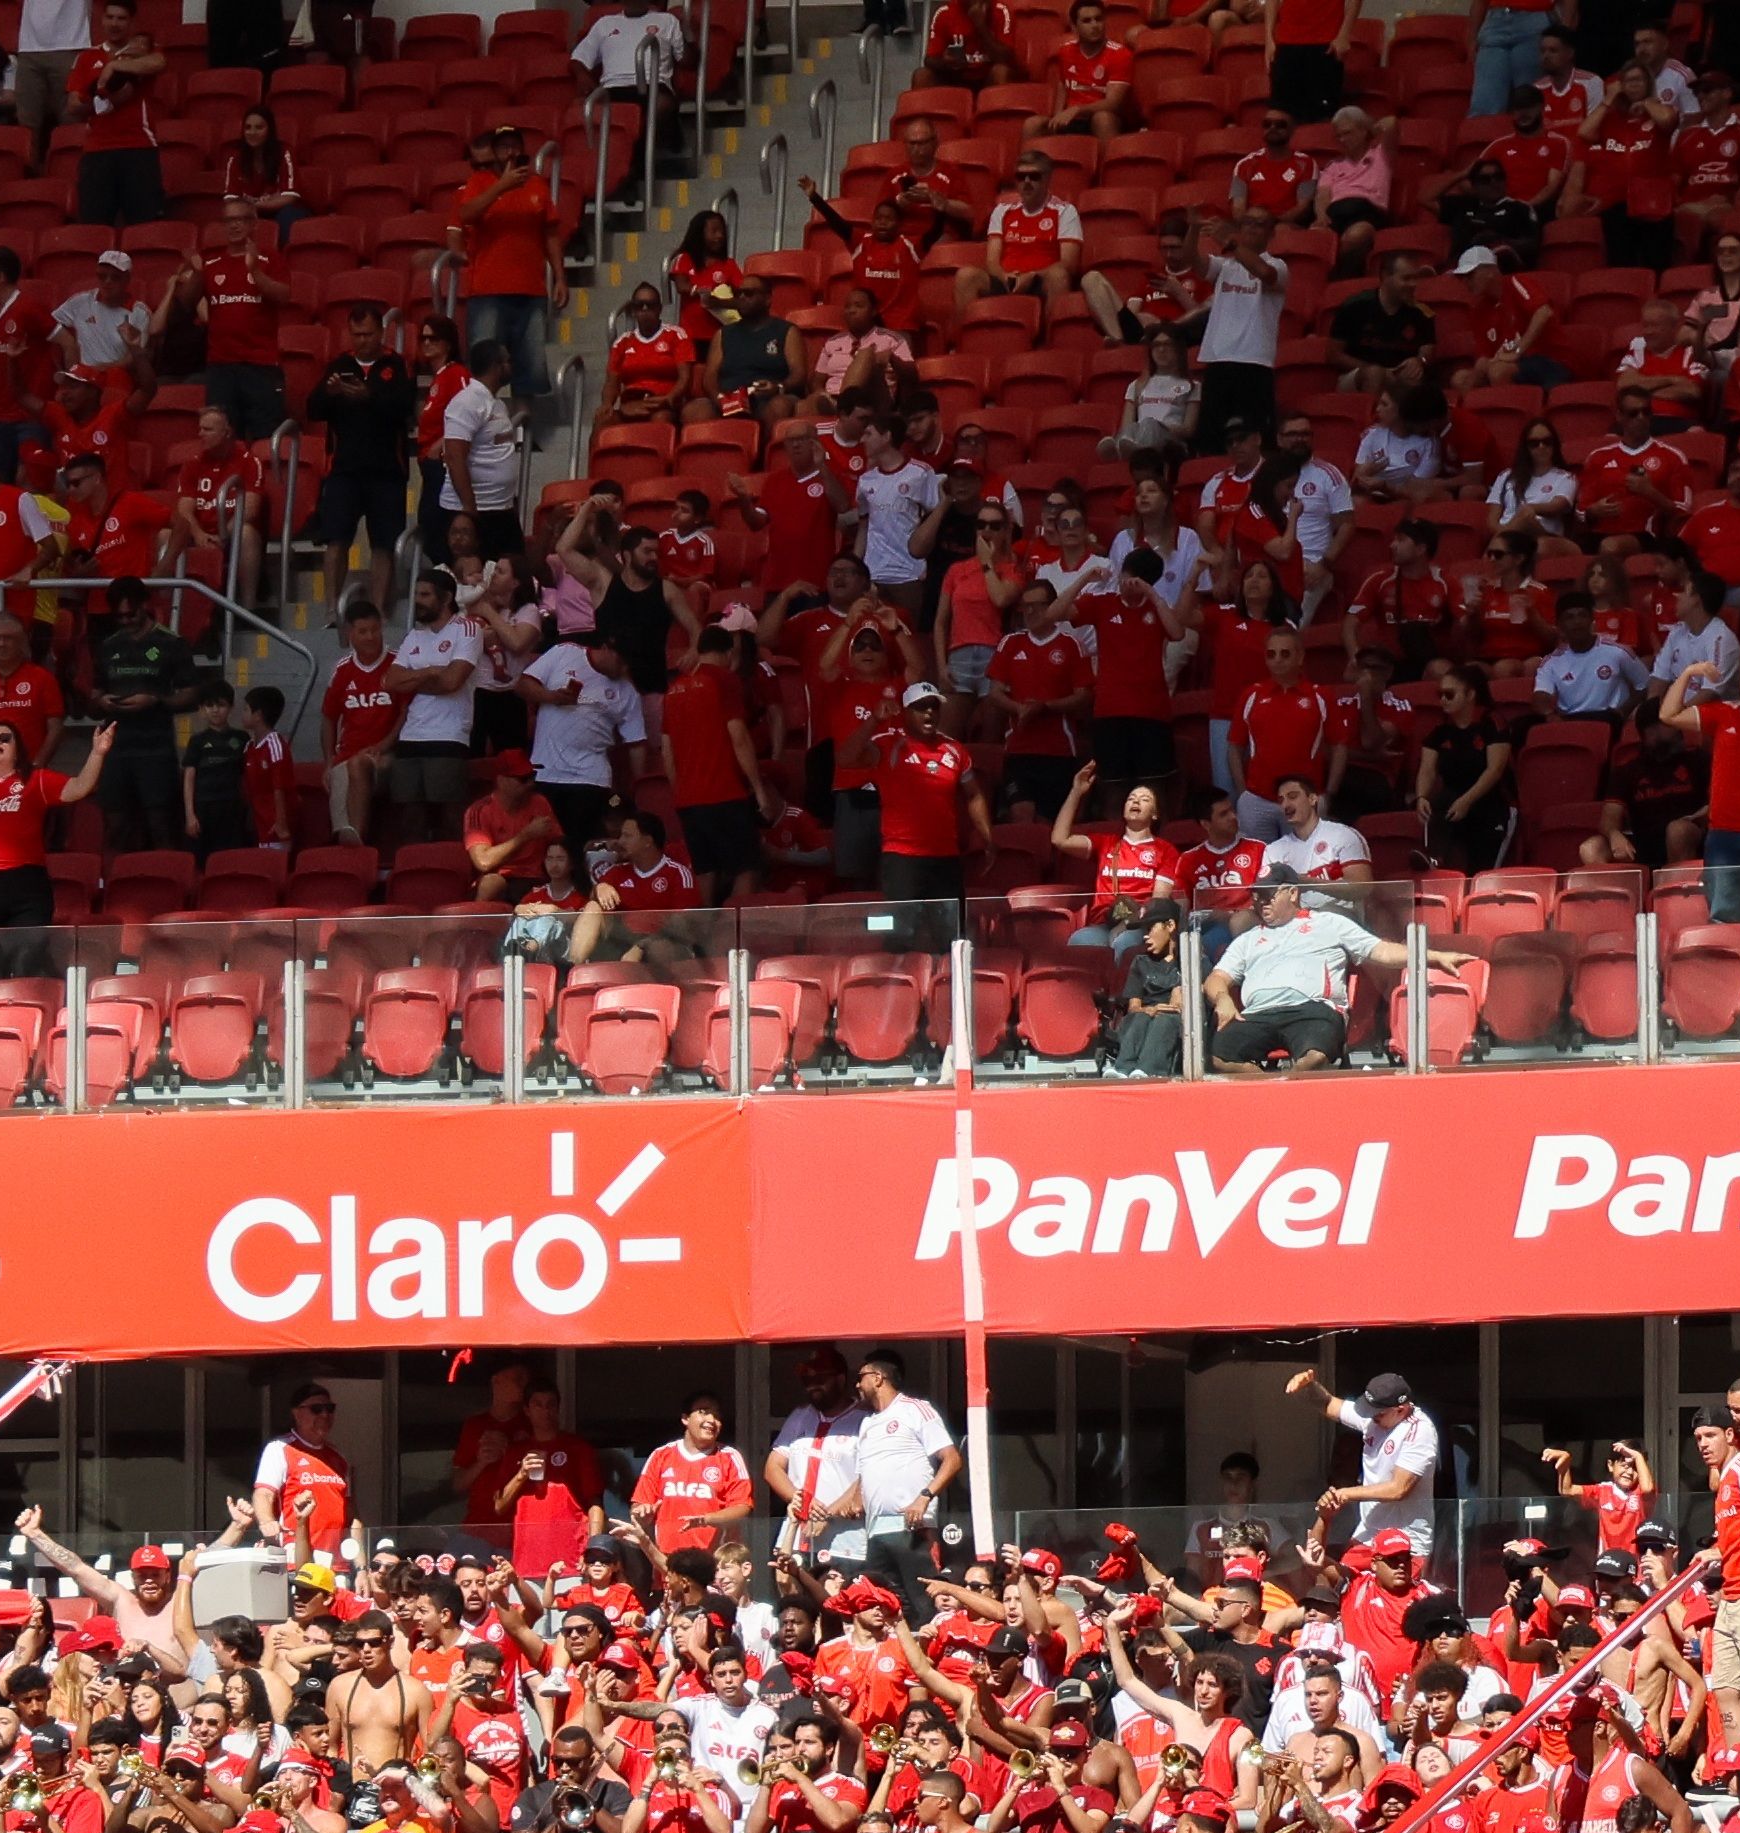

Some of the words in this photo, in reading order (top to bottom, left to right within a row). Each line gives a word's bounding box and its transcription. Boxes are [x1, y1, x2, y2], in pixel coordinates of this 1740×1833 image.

[345, 691, 391, 707] alfa
[1112, 867, 1155, 880] anrisul
[915, 1141, 1390, 1261] PanVel
[207, 1194, 609, 1323] Claro
[666, 1482, 712, 1499] alfa
[710, 1744, 758, 1759] alfa
